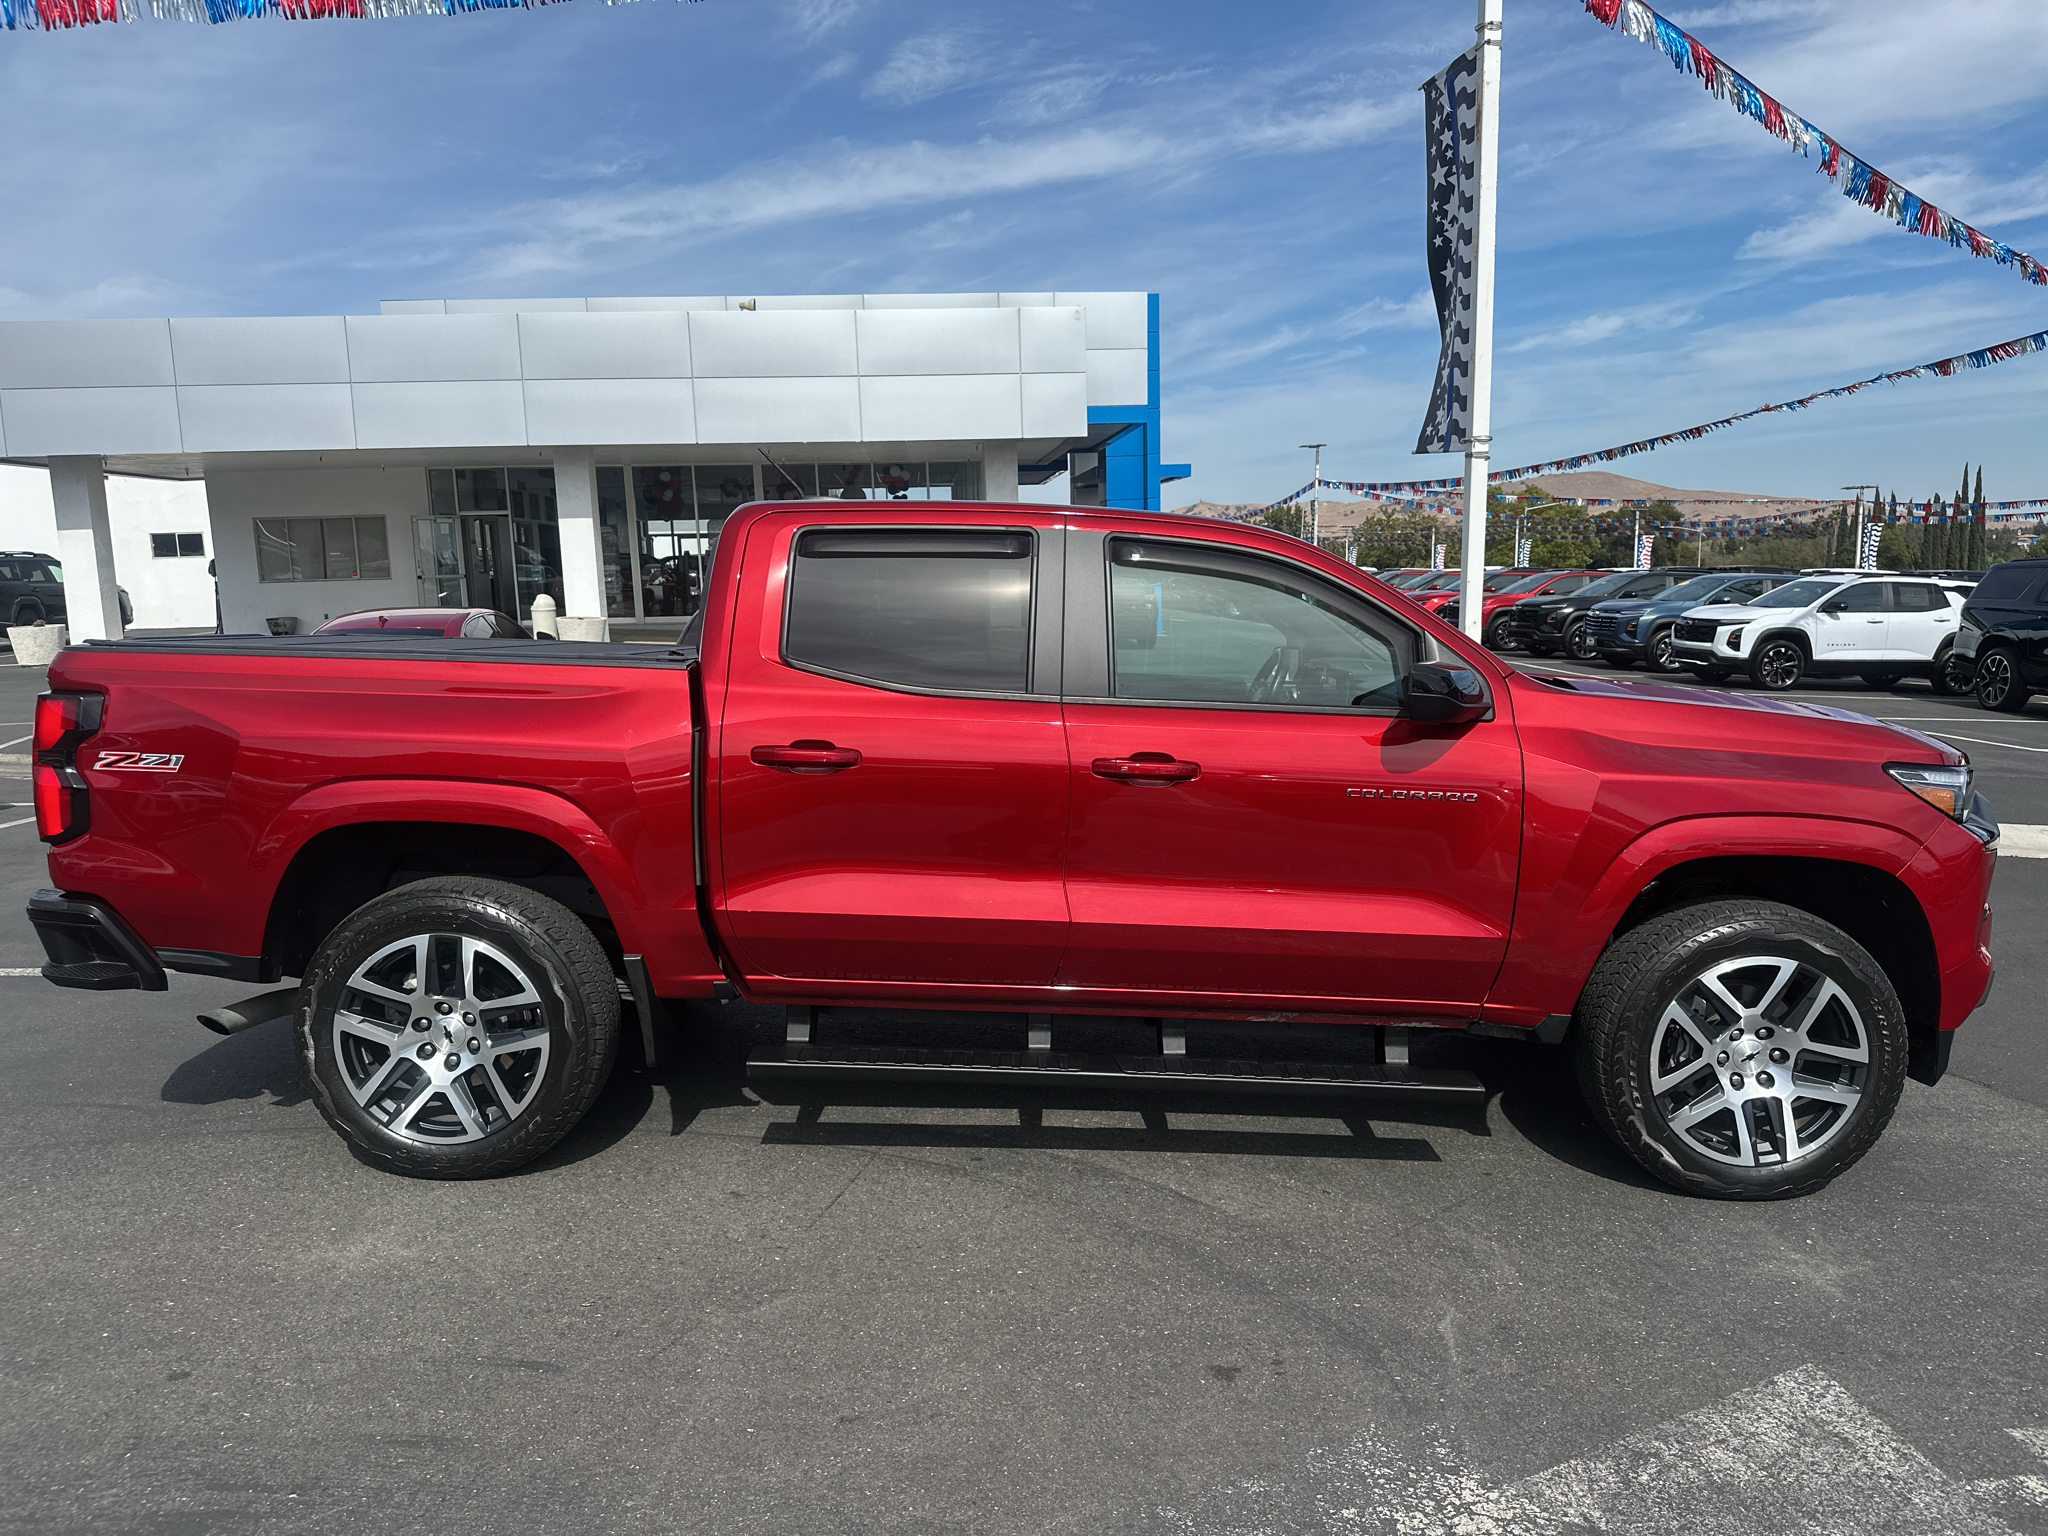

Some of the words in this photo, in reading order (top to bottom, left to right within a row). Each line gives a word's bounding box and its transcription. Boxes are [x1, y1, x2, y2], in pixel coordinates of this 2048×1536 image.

[93, 751, 185, 772] Z71
[1346, 788, 1478, 802] COLORADO
[323, 910, 470, 983] BRIDGESTONE
[1846, 996, 1893, 1151] BRIDGESTONE
